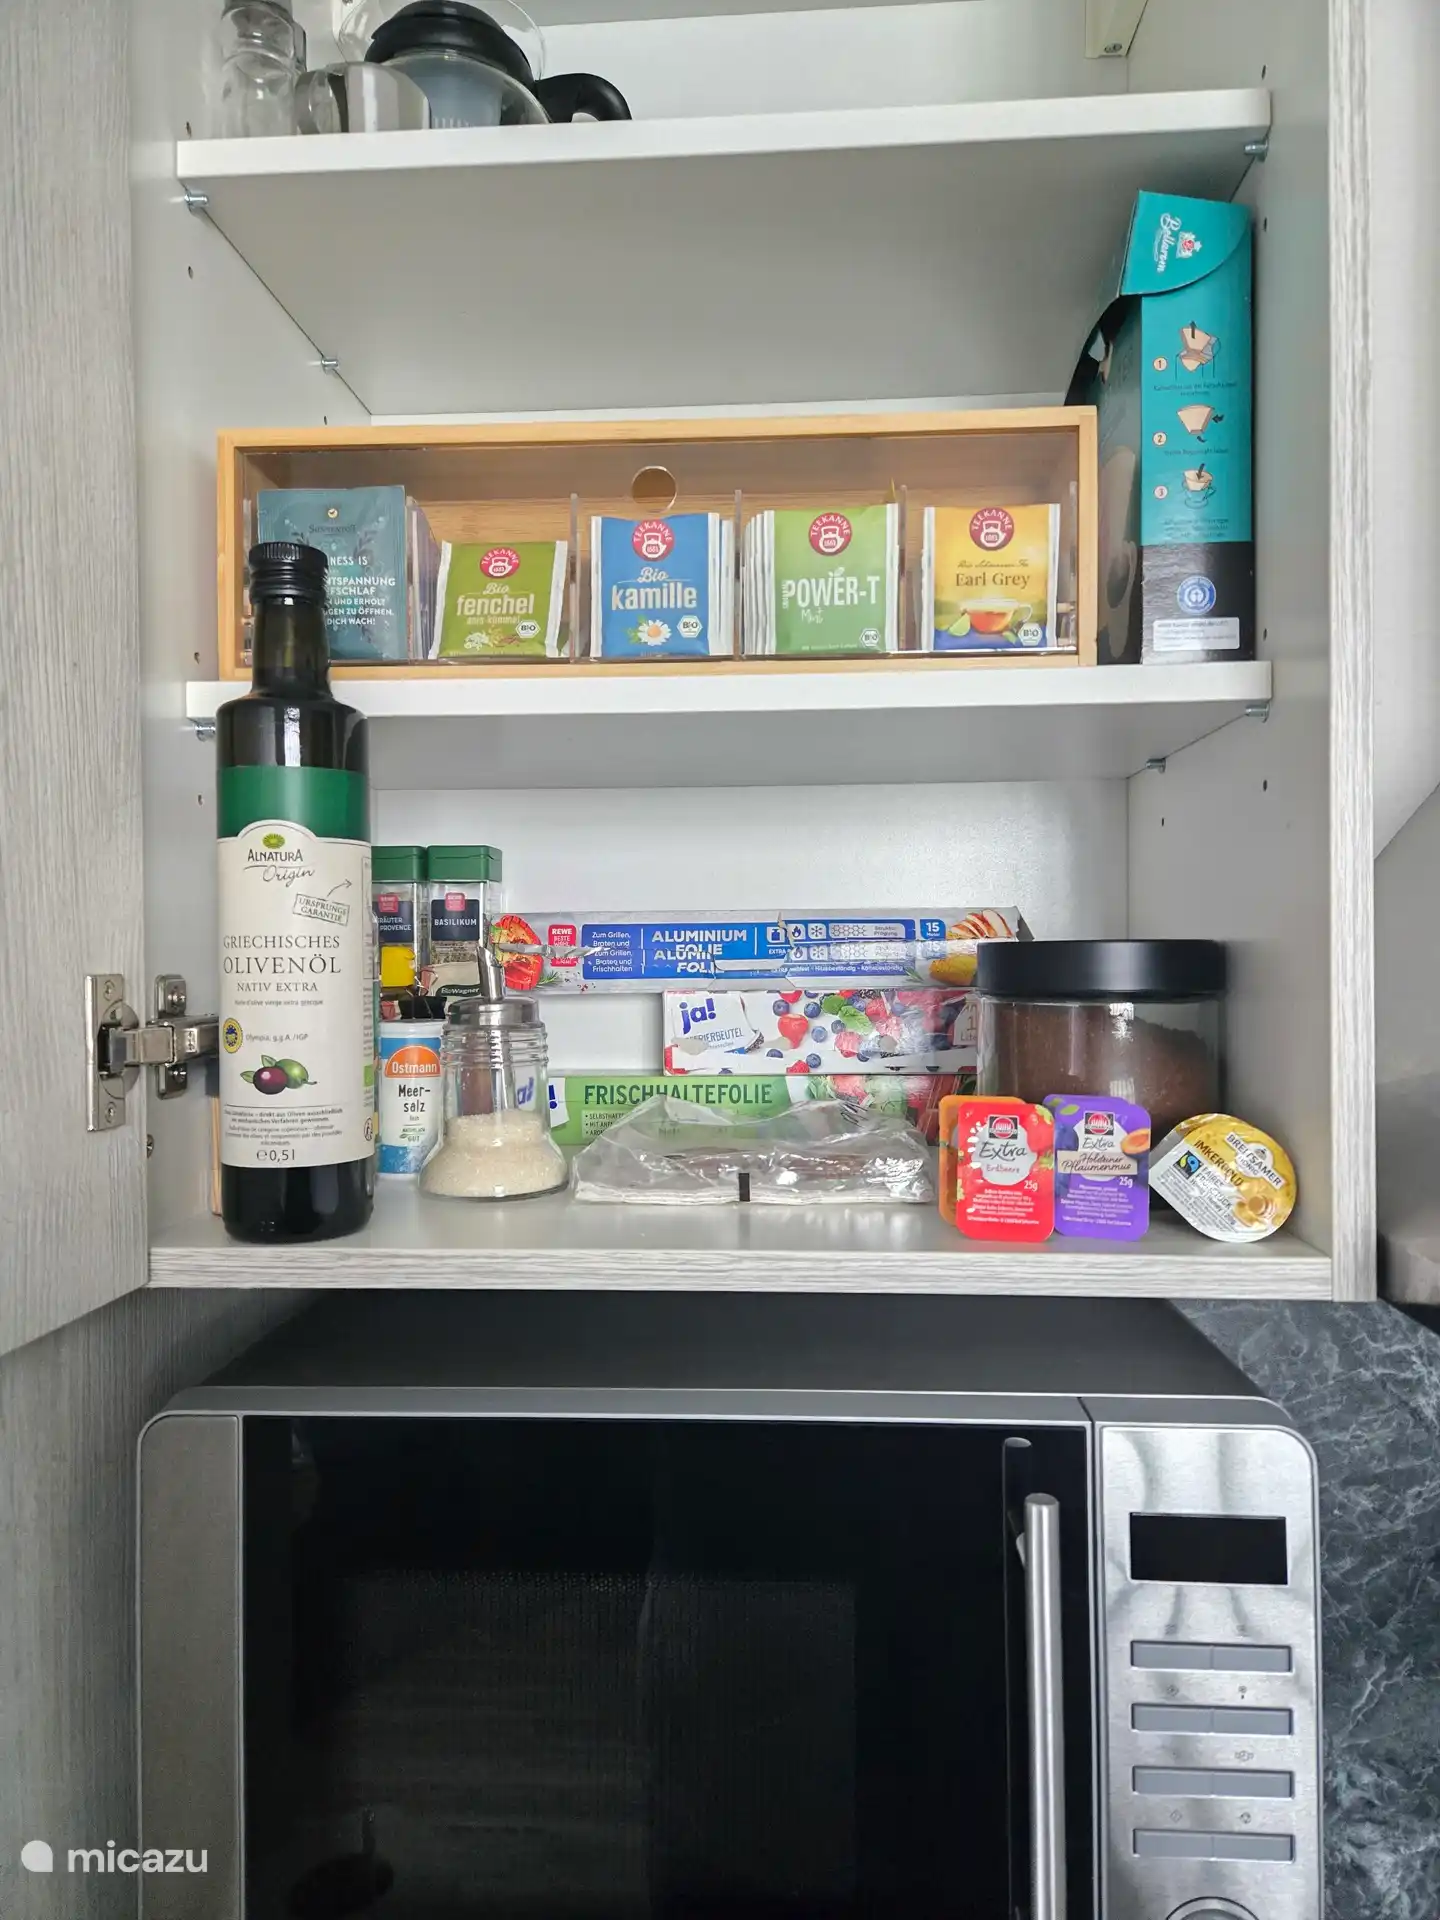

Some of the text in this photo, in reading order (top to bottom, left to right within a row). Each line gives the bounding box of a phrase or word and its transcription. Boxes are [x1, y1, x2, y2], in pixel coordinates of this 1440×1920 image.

[809, 513, 852, 537] TEEKANNE
[971, 509, 1013, 531] TEEKANNE
[632, 521, 673, 543] TEEKANNE
[358, 555, 368, 566] IS
[480, 548, 520, 565] TEEKANNE
[637, 566, 669, 583] Bio
[955, 571, 1030, 590] Earl Grey
[482, 582, 510, 595] Bio
[782, 575, 881, 608] POWER-T
[611, 582, 697, 611] kamille
[456, 593, 535, 616] fenchel
[682, 620, 699, 629] BIO
[247, 849, 304, 862] ALNATURA
[262, 865, 315, 888] Origin
[300, 905, 344, 922] GARANTIE
[434, 918, 477, 926] BASILIKUM
[925, 921, 940, 933] 15
[223, 934, 341, 950] GRIECHISCHES
[607, 931, 631, 939] Grillen,
[651, 929, 747, 943] ALUMINIUM
[223, 953, 342, 975] OLIVENÖL
[592, 965, 633, 973] Frischhalten
[237, 982, 319, 992] NATIV EXTRA
[679, 997, 716, 1035] ja!
[391, 1061, 437, 1075] Ostmann
[398, 1084, 431, 1098] Meer-
[584, 1084, 773, 1105] FRISCHHALTEFOLIE
[403, 1099, 426, 1113] salz
[978, 1140, 1028, 1162] Extra
[1082, 1136, 1116, 1151] Extra
[1023, 1179, 1039, 1192] 25g
[1118, 1175, 1134, 1189] 25g
